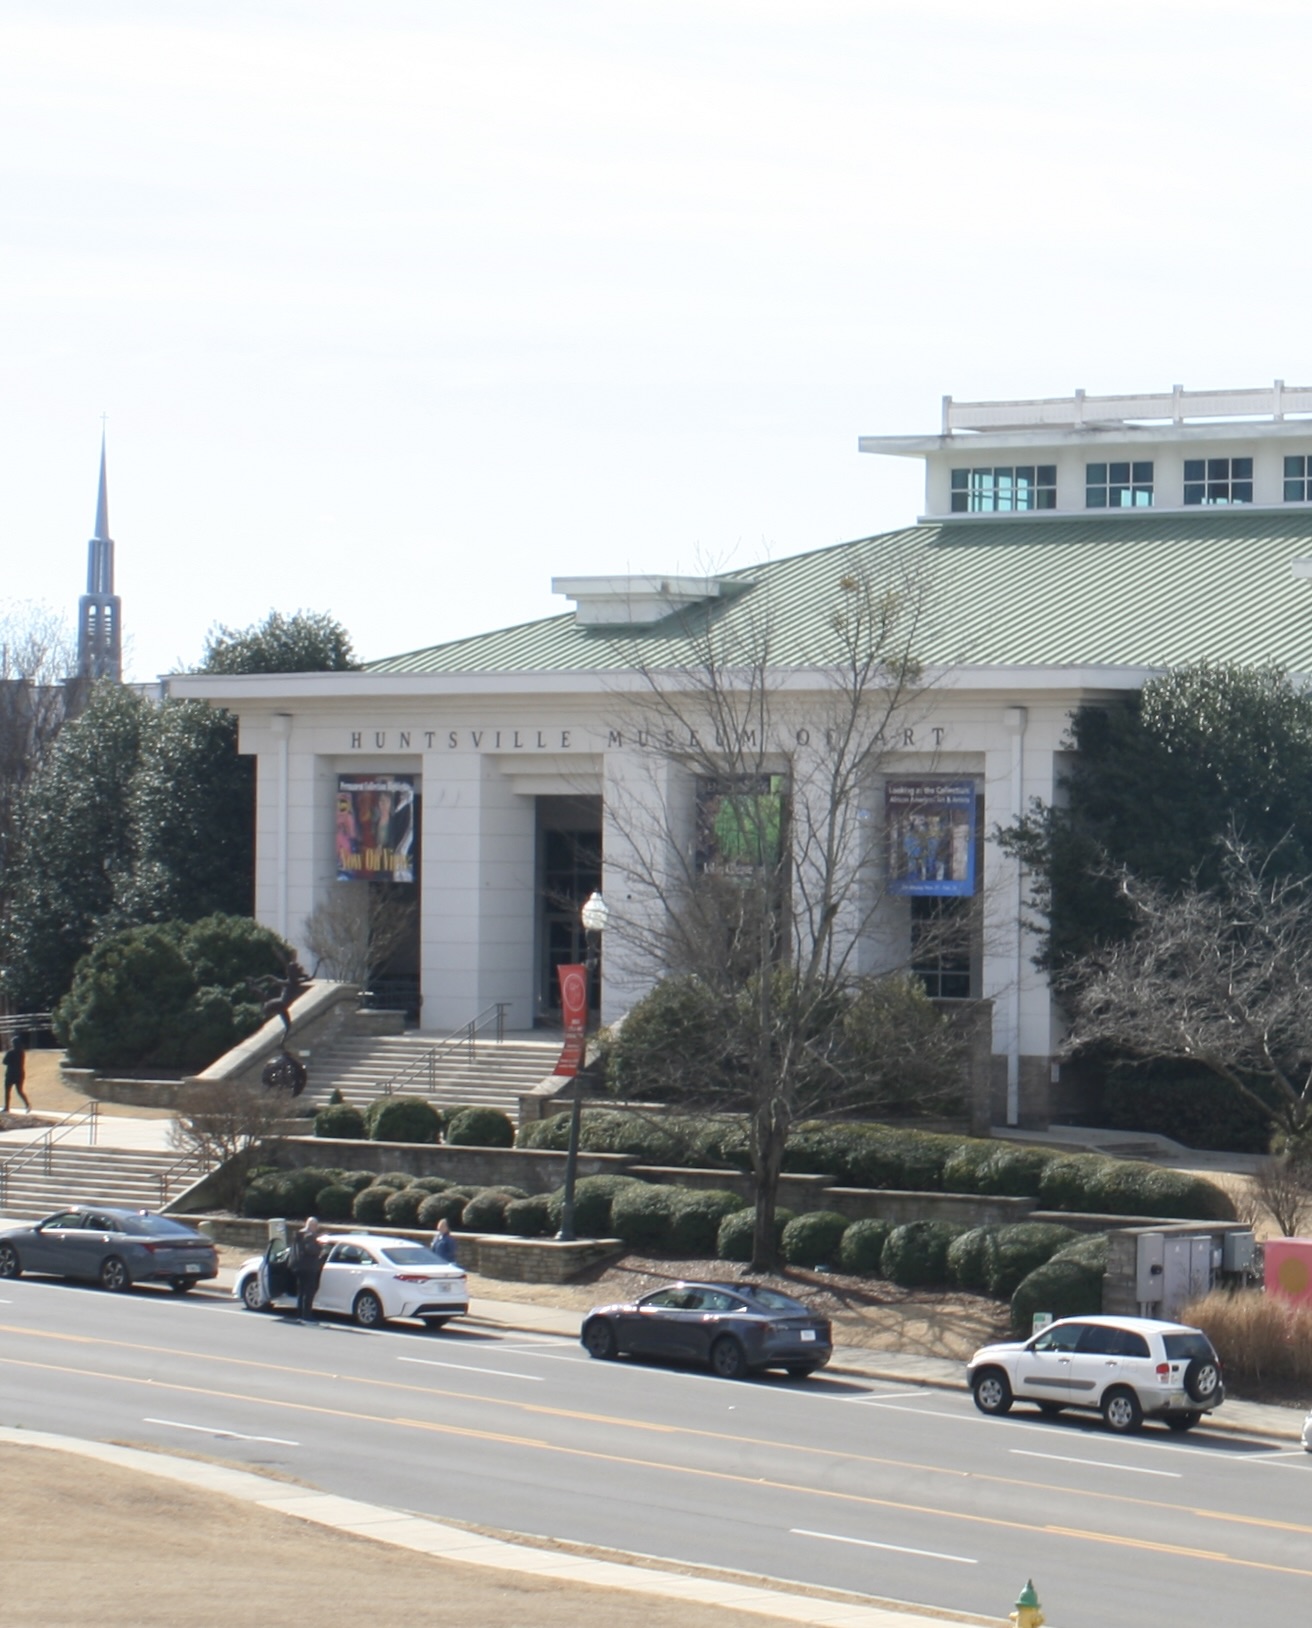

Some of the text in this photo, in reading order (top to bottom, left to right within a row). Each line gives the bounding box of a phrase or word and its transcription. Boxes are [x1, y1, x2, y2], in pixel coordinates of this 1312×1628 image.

[351, 726, 945, 749] HUNTSVILLE MUSEUM OF ART
